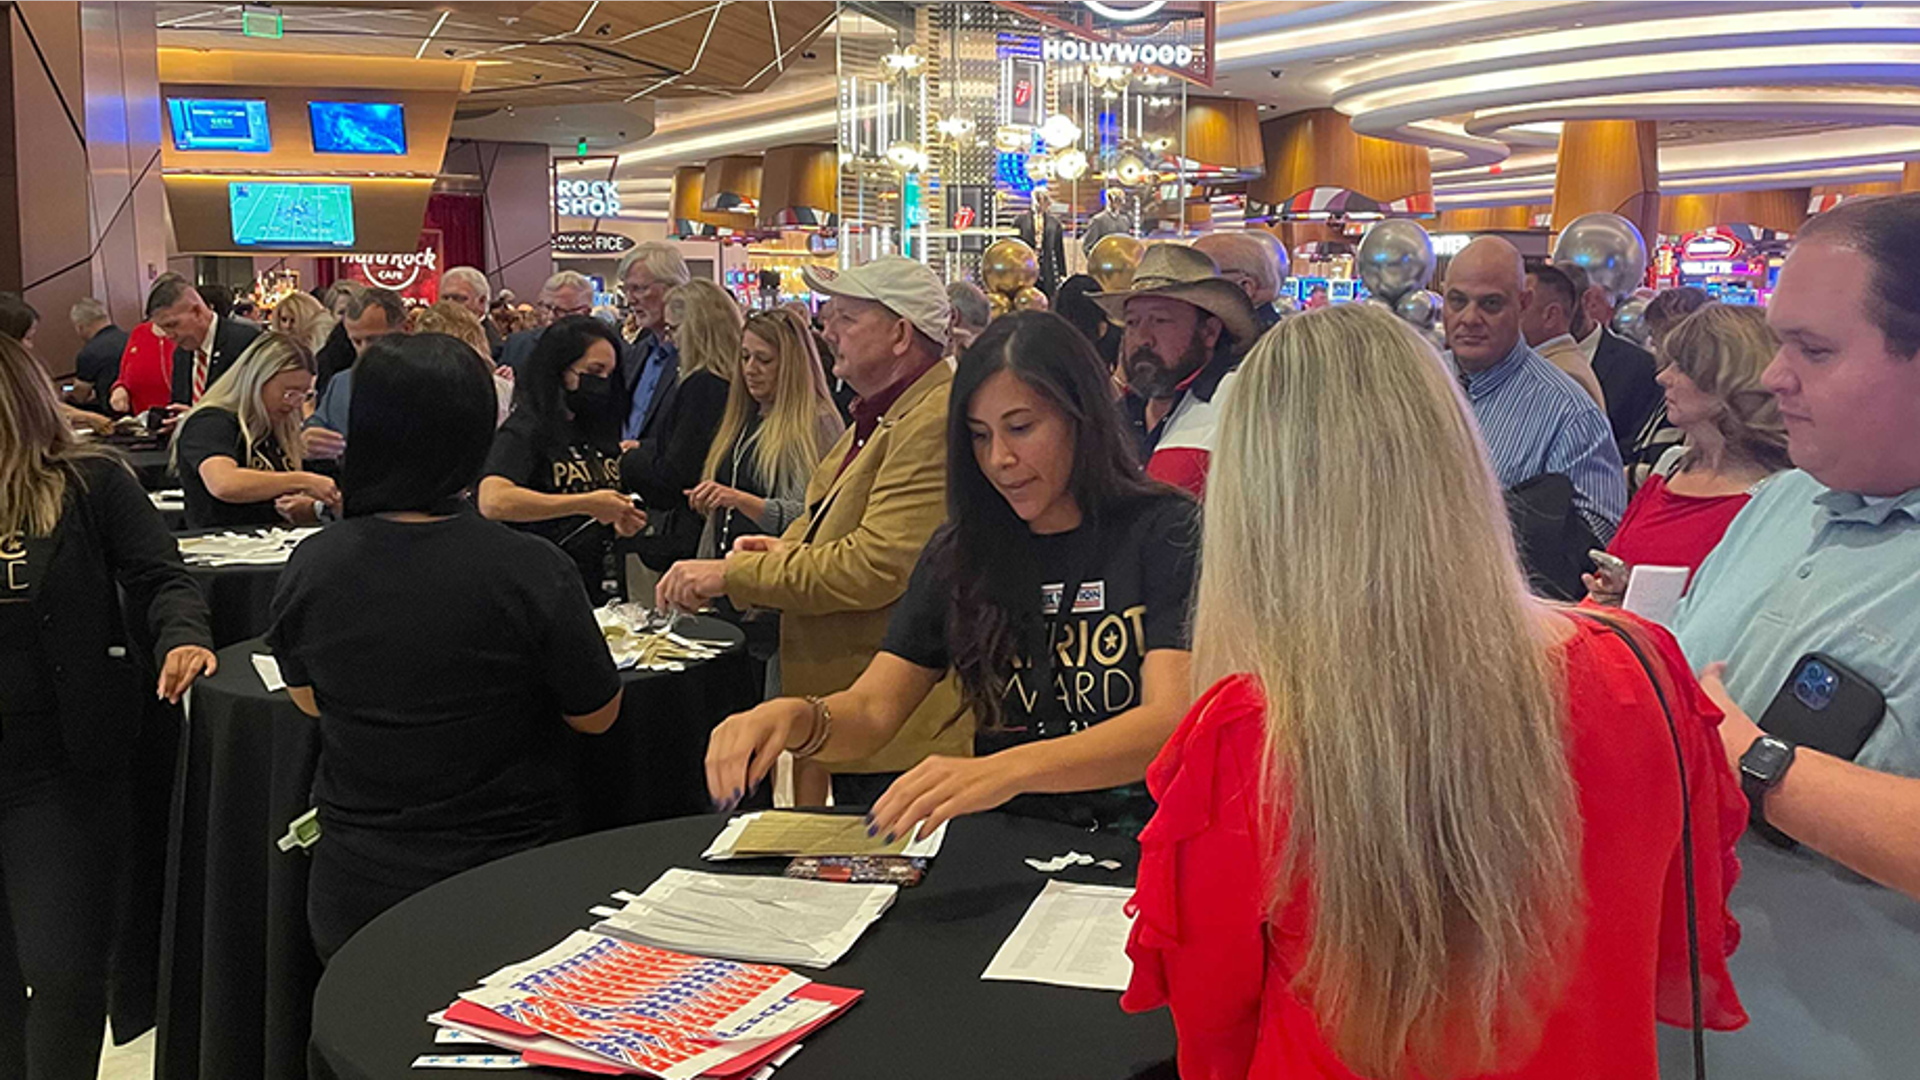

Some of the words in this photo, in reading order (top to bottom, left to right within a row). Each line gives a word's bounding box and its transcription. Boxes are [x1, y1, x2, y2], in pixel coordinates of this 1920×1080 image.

[1043, 40, 1193, 66] HOLLYWOOD
[557, 180, 619, 198] ROCK
[557, 199, 620, 217] SHOP
[1010, 605, 1147, 669] RIOT
